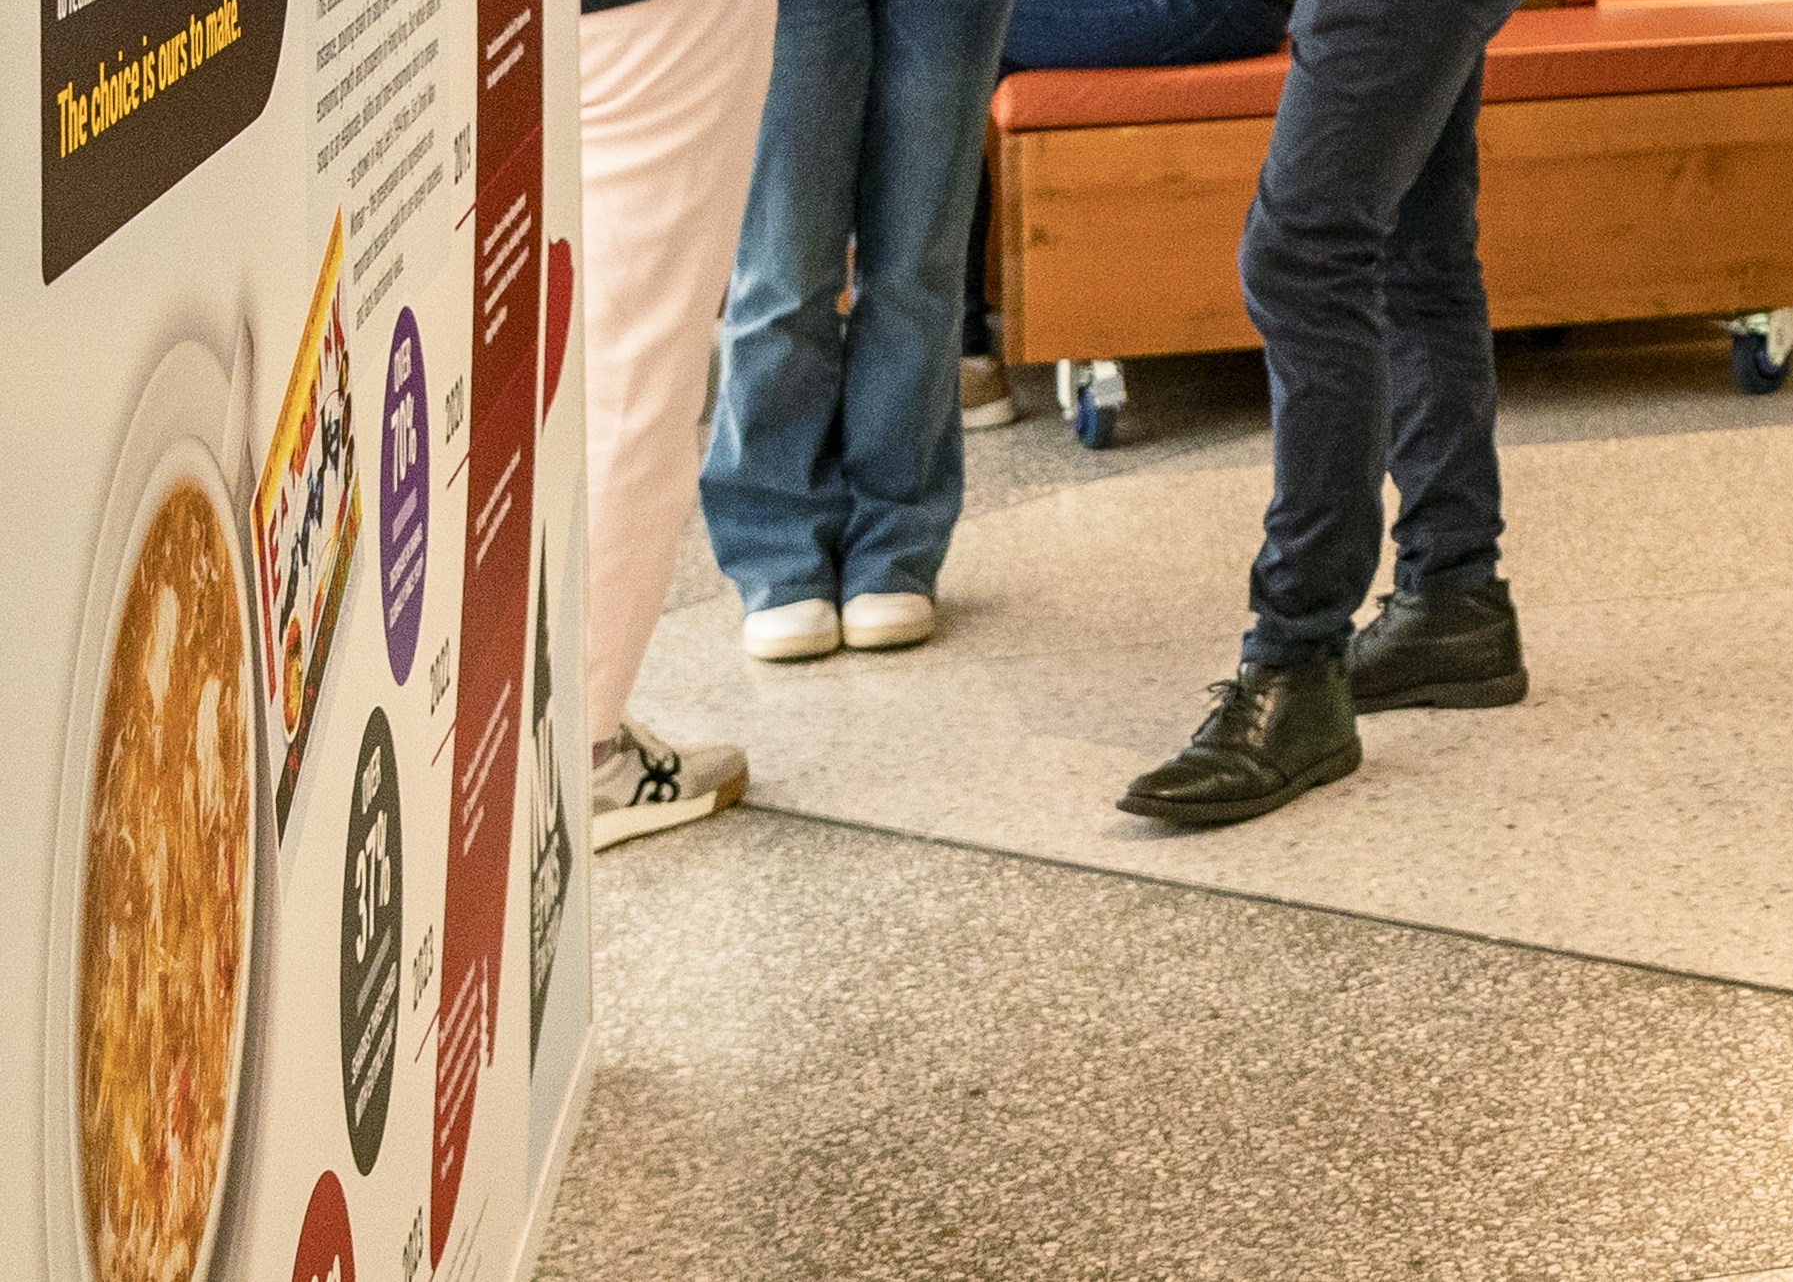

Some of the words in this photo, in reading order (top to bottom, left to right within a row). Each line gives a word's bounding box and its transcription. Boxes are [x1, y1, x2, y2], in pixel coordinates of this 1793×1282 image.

[57, 82, 88, 158] The
[90, 51, 139, 137] choice
[142, 36, 155, 102] is
[158, 30, 188, 91] ours
[189, 14, 203, 70] to
[394, 337, 413, 393] OVER
[391, 391, 417, 493] 70%
[446, 373, 464, 445] 2020
[430, 636, 451, 716] 2022
[362, 745, 382, 815] OVER
[356, 810, 391, 964] 37%
[413, 923, 434, 1012] 2023
